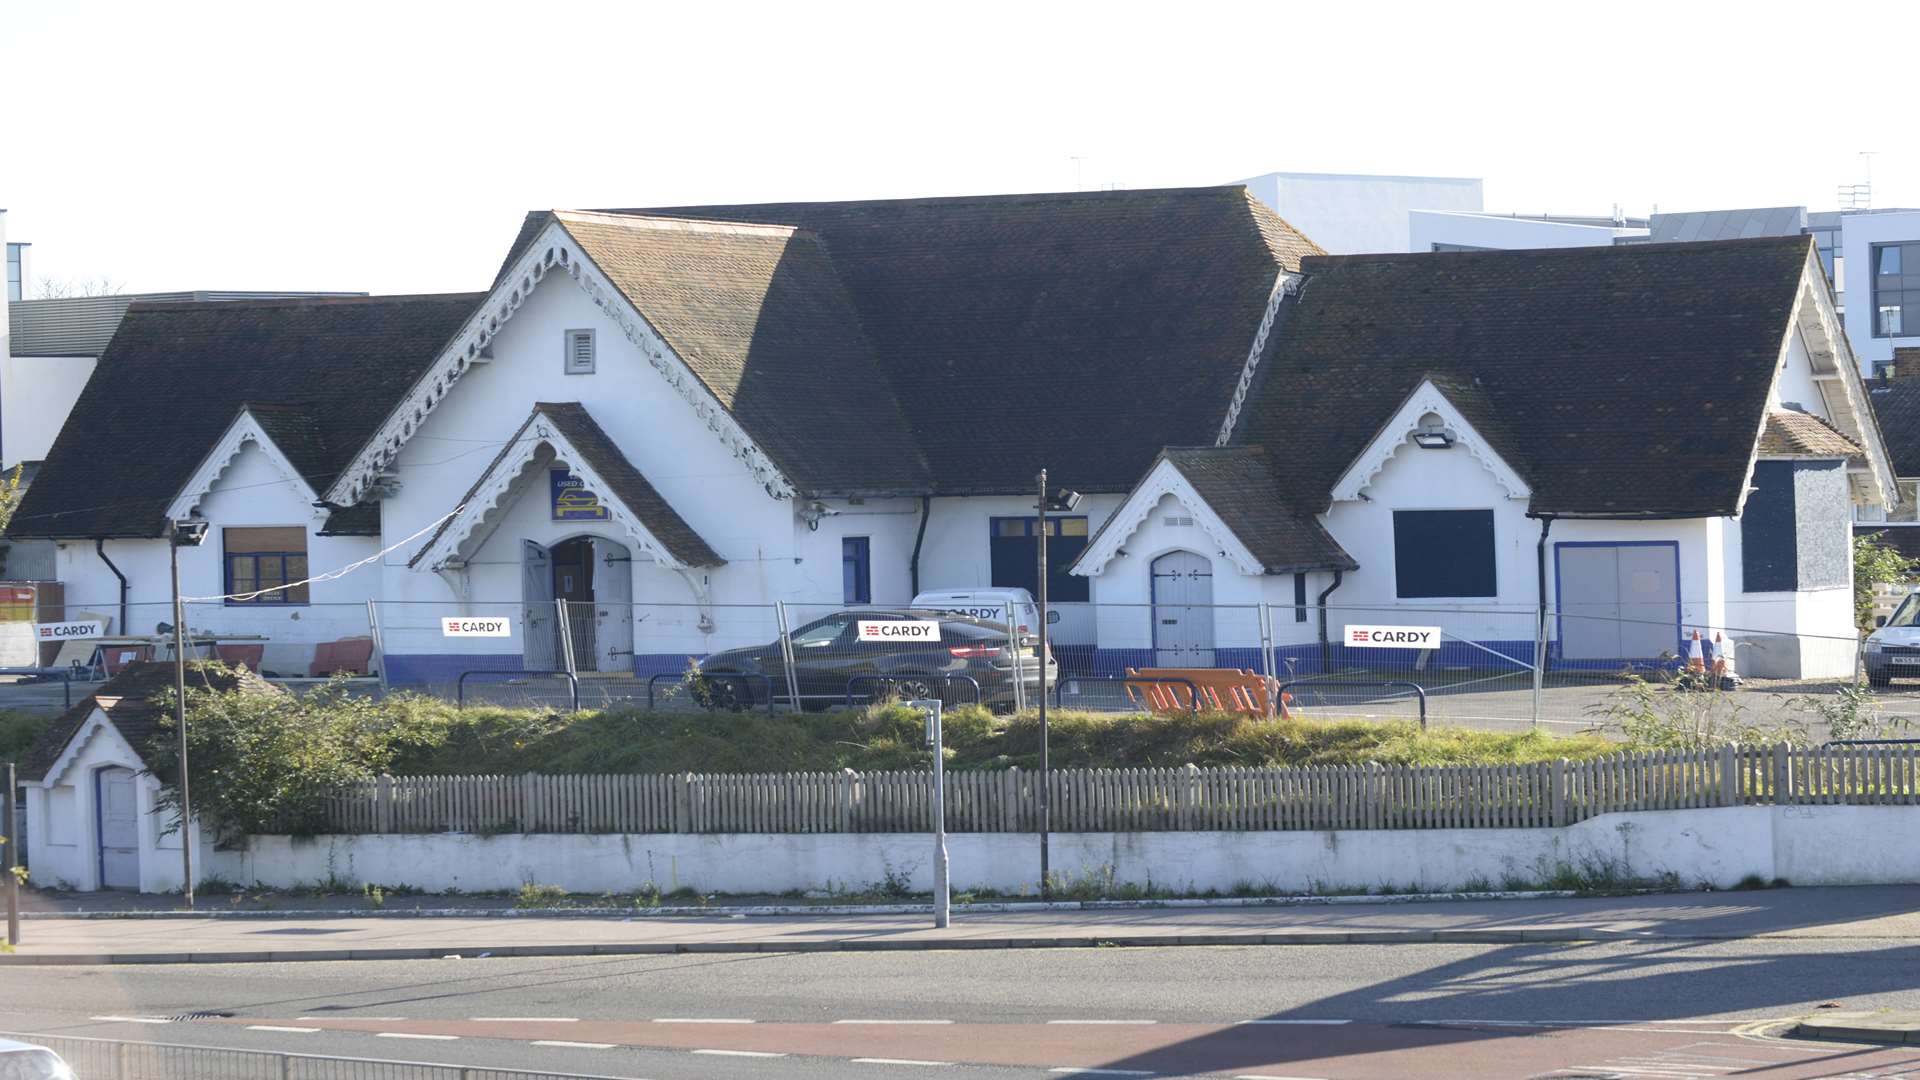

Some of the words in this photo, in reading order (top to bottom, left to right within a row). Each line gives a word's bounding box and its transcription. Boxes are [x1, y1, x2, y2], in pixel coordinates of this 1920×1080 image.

[54, 624, 96, 636] CARDY
[462, 622, 503, 632] CARDY
[881, 625, 931, 636] CARDY
[1372, 631, 1431, 643] CARDY
